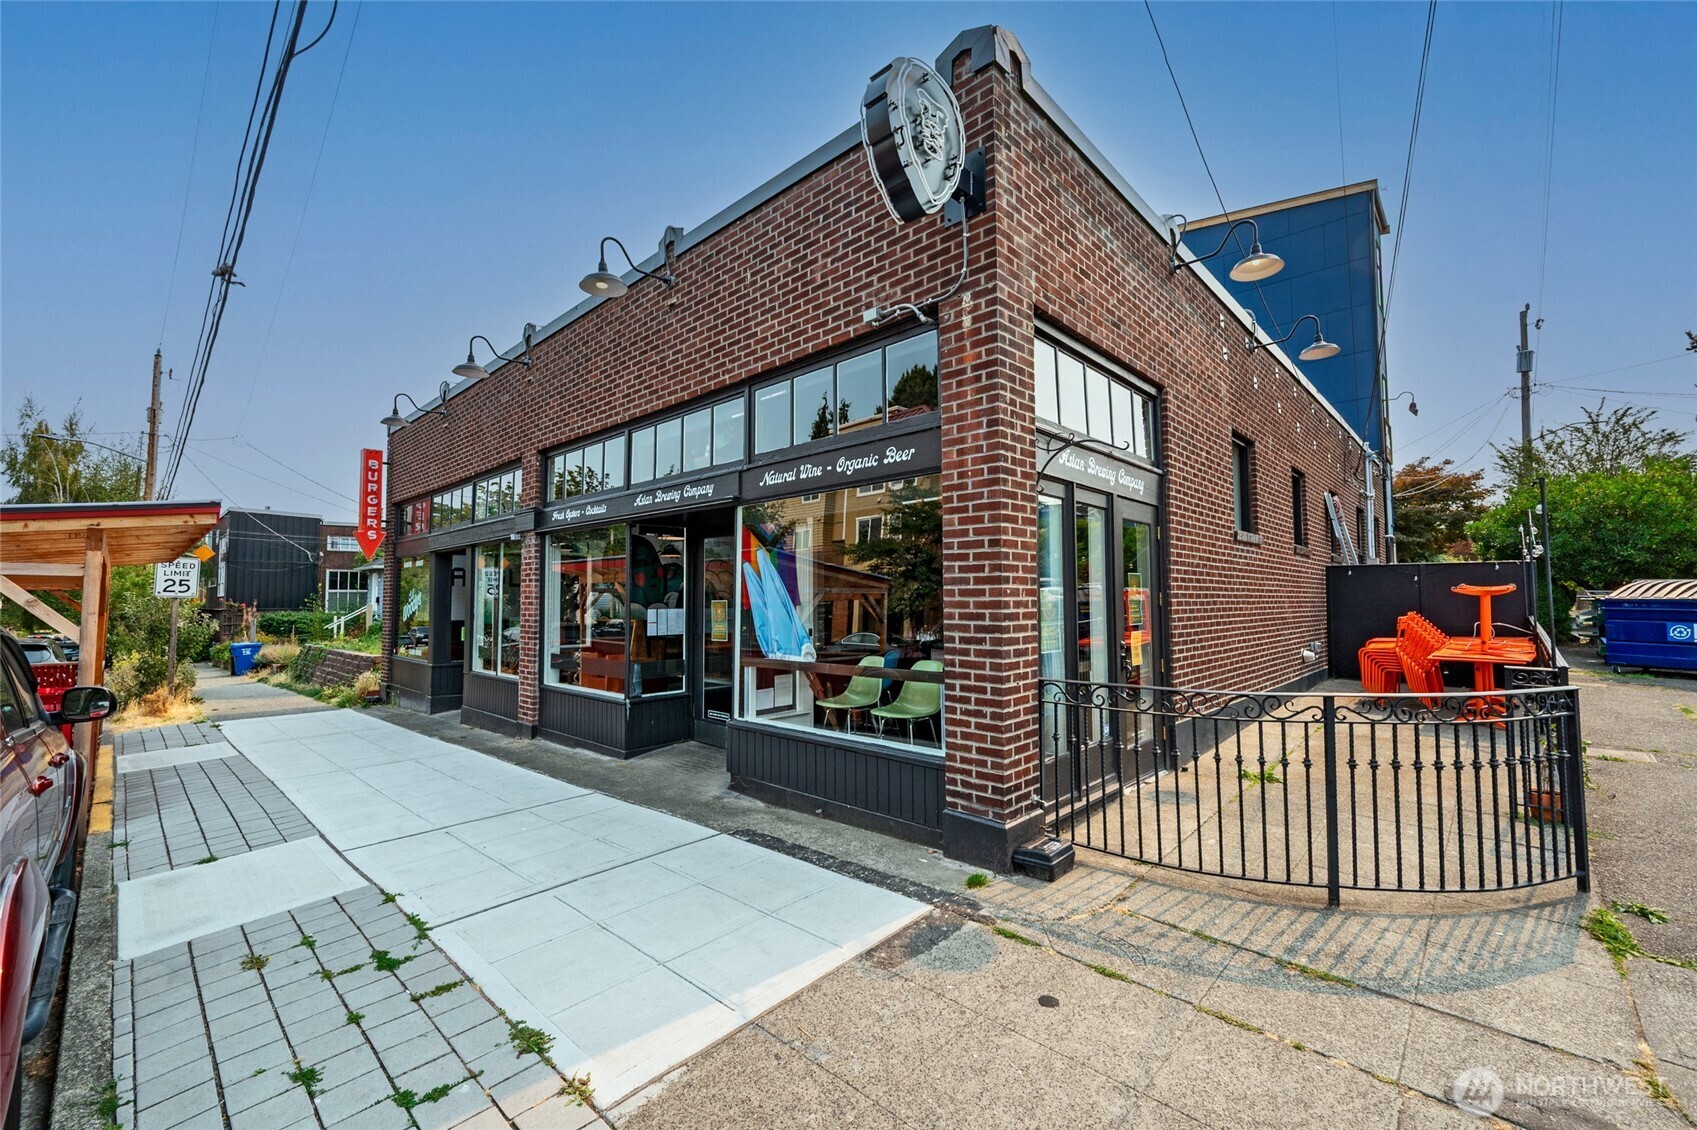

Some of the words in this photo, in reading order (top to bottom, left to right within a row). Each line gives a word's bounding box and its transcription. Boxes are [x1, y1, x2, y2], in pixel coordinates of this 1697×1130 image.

[759, 468, 797, 487] Natural
[800, 463, 823, 480] Wine
[836, 453, 879, 475] Organic
[883, 446, 915, 465] Beer
[1087, 457, 1117, 486] Brewing
[1118, 468, 1145, 495] Company
[367, 459, 379, 540] BURGERS
[654, 489, 681, 503] Brewing
[683, 483, 715, 499] Company
[160, 562, 196, 570] SPEED
[162, 578, 191, 594] 25
